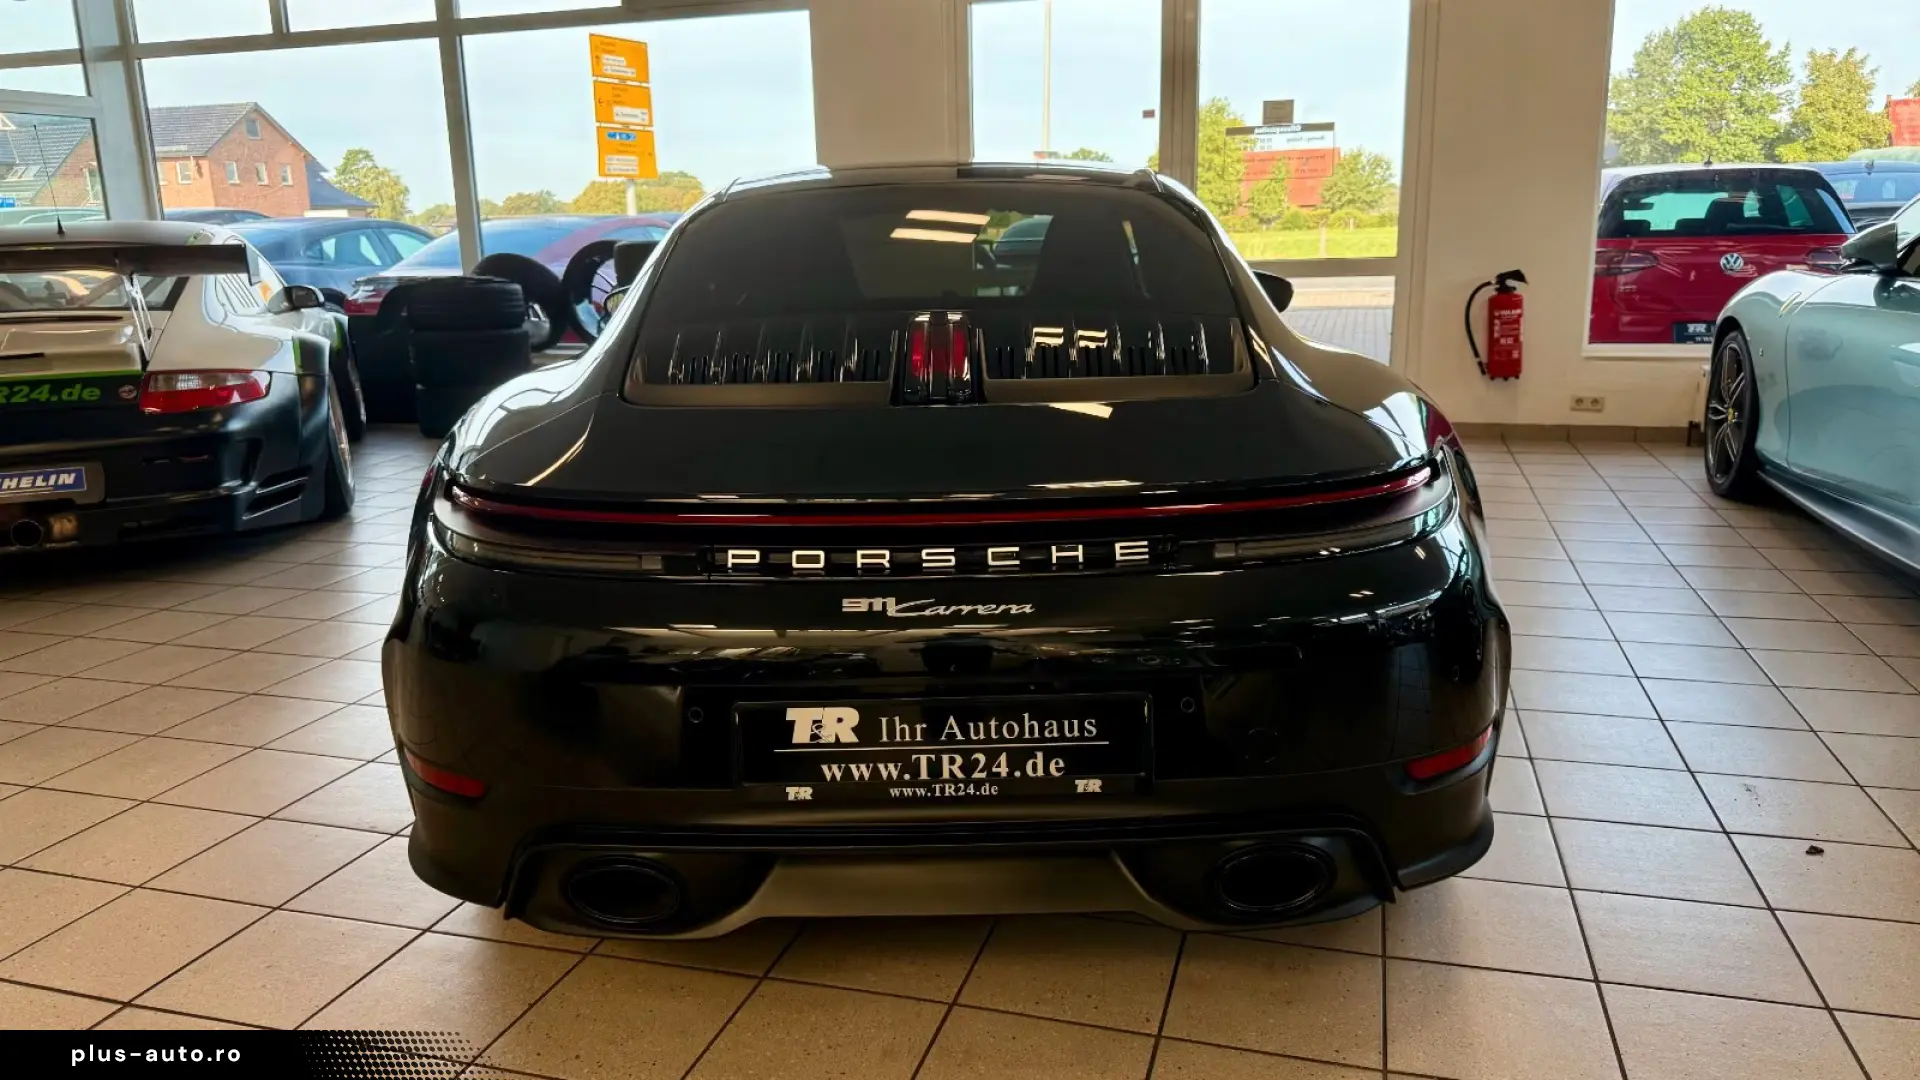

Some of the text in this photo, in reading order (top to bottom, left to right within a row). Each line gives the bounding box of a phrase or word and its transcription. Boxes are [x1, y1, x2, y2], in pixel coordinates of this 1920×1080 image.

[0, 473, 76, 490] HELIN
[727, 541, 1149, 569] PORSCHE
[841, 597, 1035, 617] 911 Carrera
[879, 716, 927, 742] Ihr
[940, 713, 1098, 741] Autohaus
[820, 751, 1066, 782] www.TR24.de
[889, 783, 999, 798] www.TR24.de
